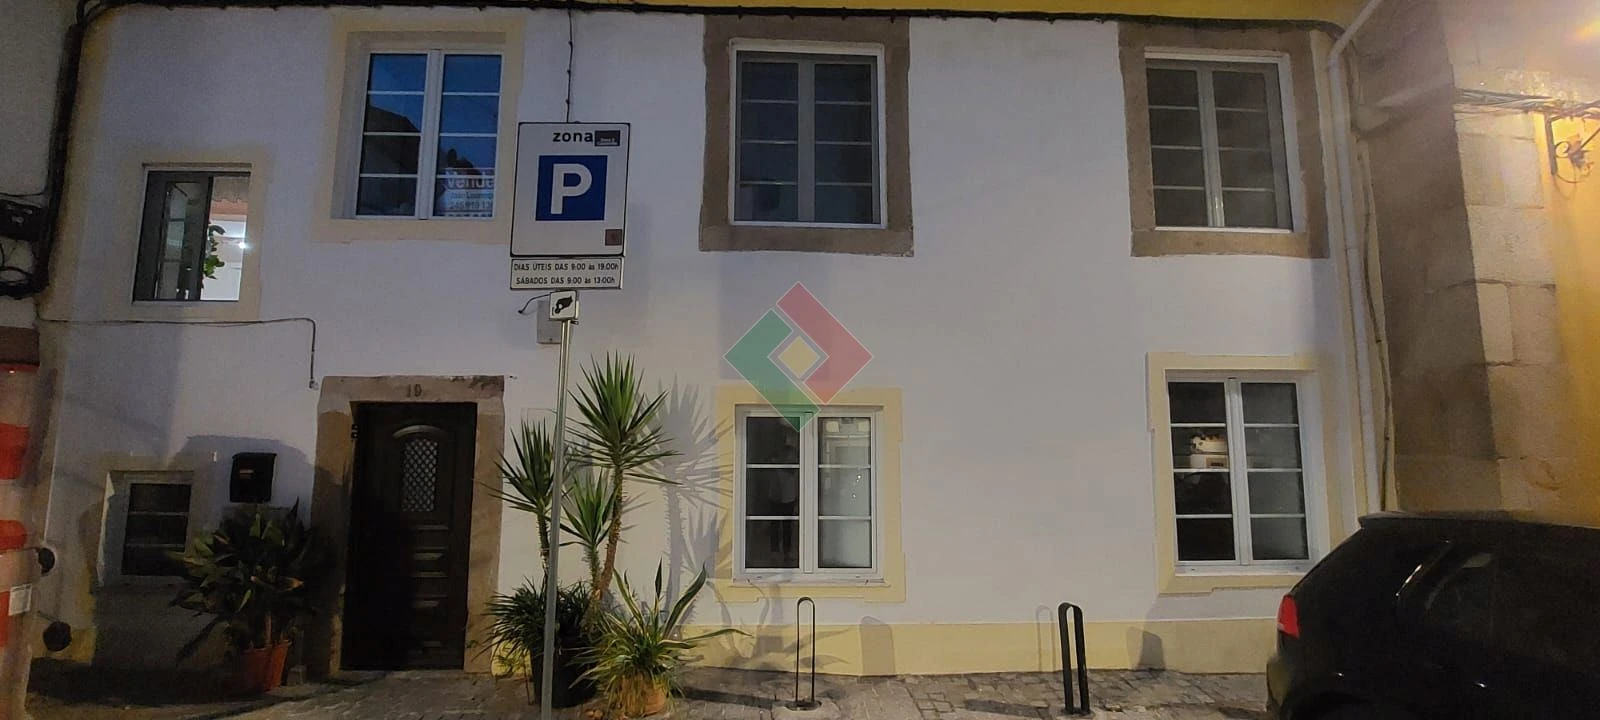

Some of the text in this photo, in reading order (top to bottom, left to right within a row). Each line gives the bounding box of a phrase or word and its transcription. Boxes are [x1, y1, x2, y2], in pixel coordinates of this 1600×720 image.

[552, 131, 593, 143] zona
[550, 163, 593, 215] P
[513, 263, 529, 271] DIAS
[516, 275, 548, 284] SÁBADOS
[550, 276, 565, 284] DAS
